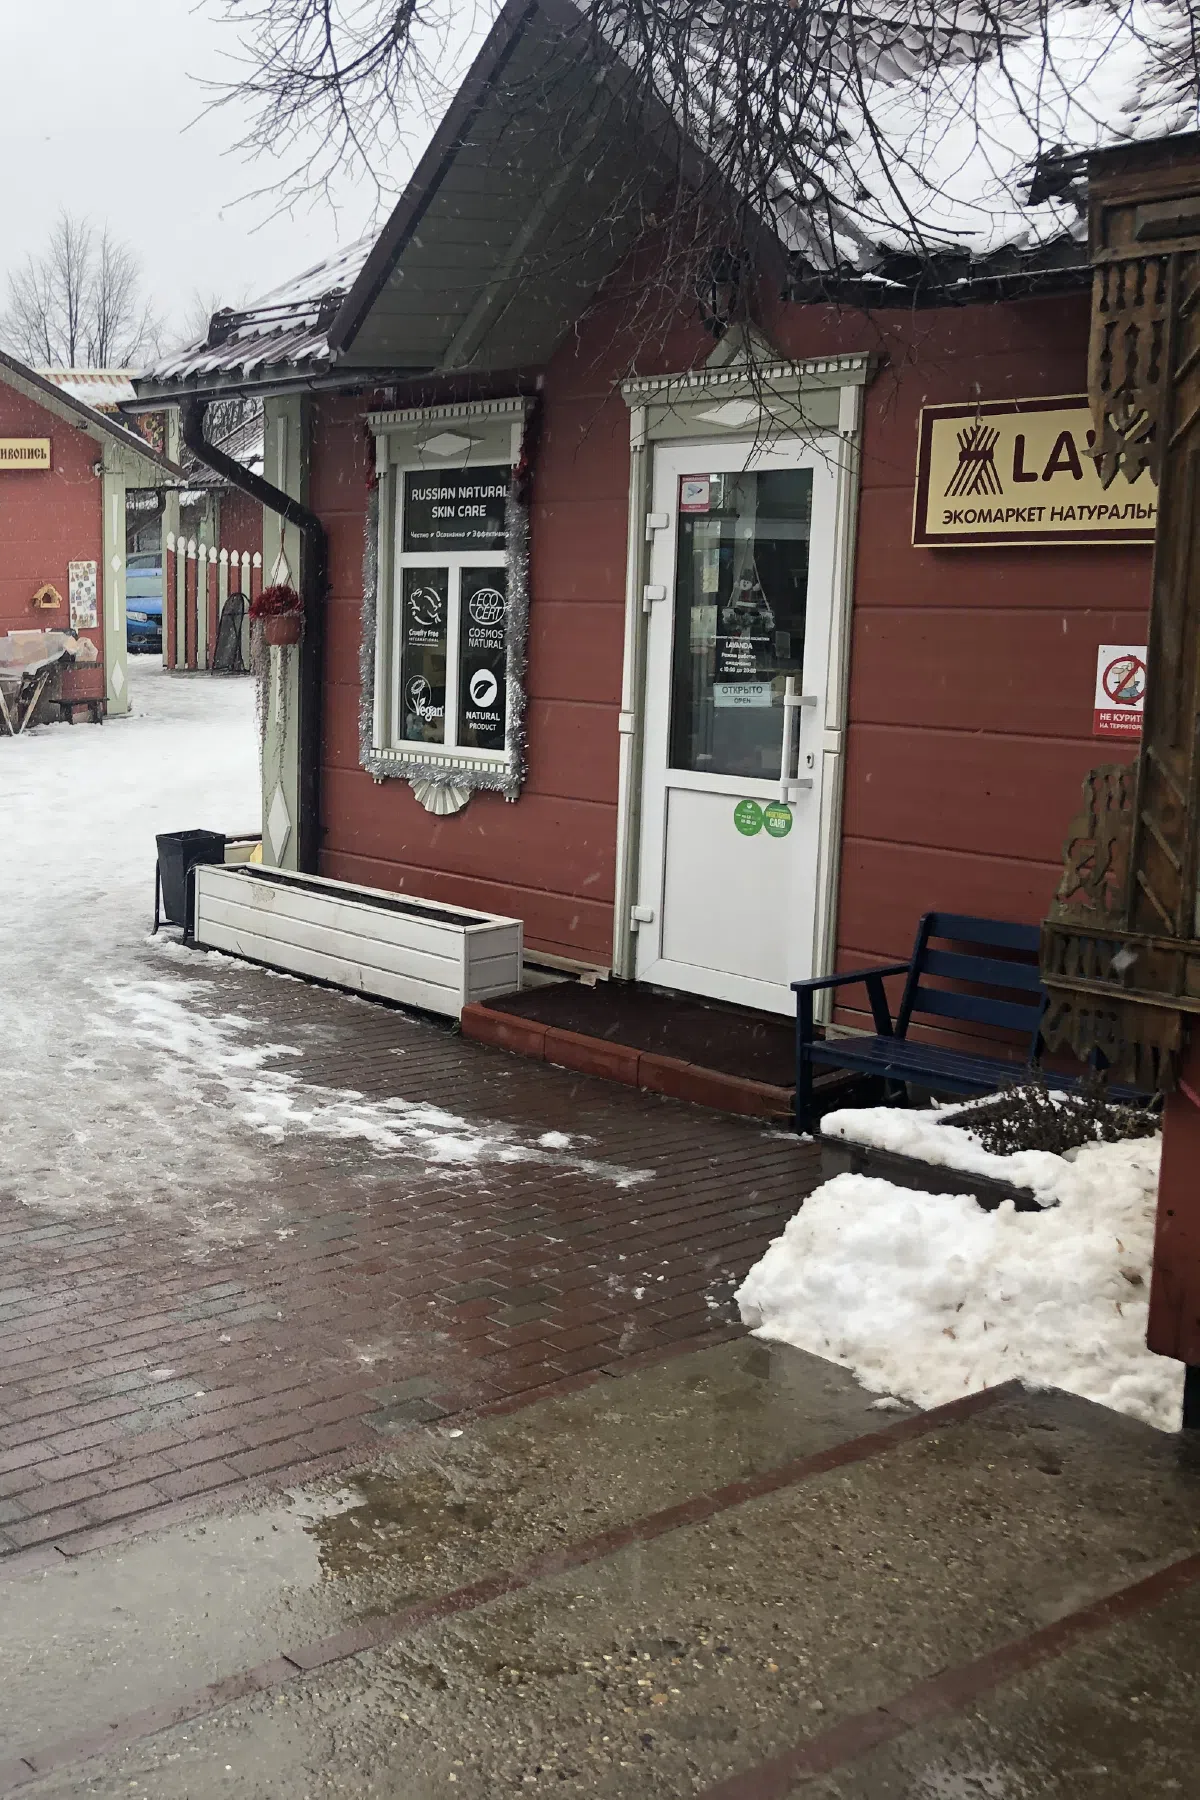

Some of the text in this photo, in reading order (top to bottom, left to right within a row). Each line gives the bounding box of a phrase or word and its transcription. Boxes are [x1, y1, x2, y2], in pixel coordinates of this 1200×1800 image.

[412, 485, 508, 501] RUSSIAN NATURAL
[431, 505, 487, 518] SKIN CARE
[942, 506, 1047, 525] ЭКОМАРКЕТ
[476, 592, 499, 607] ECO
[475, 606, 503, 620] CERT
[468, 628, 504, 639] COSMOS
[468, 638, 504, 650] NATURAL
[721, 686, 763, 695] ОТКРЫТО
[465, 711, 501, 721] NATURAL
[1099, 712, 1143, 722] НЕ КУРИТ
[468, 722, 497, 731] PRODUCT
[1109, 722, 1143, 731] ТЕРРИТОР
